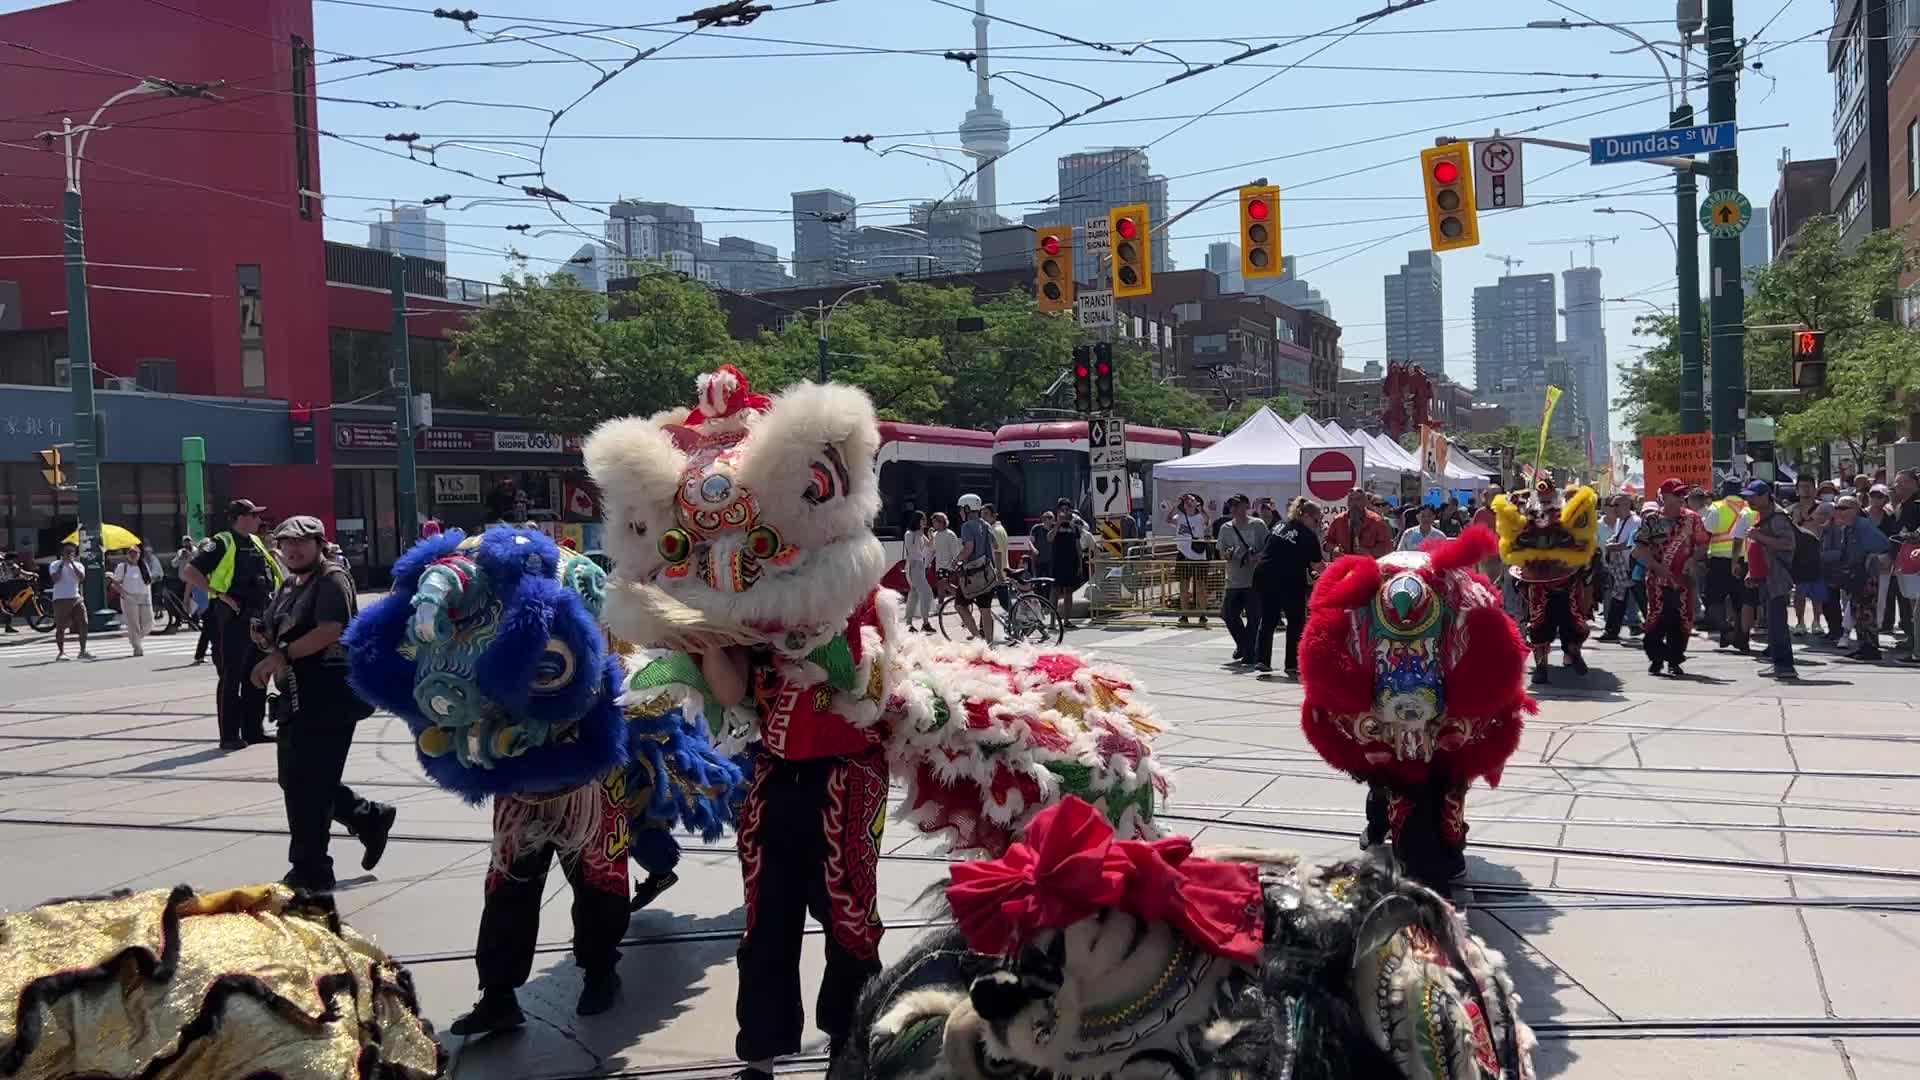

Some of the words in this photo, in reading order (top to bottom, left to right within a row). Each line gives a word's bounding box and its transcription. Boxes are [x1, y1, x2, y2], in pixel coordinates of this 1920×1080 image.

[1606, 135, 1680, 157] Dundas
[1686, 130, 1697, 140] St
[1700, 127, 1719, 146] W
[1087, 220, 1107, 229] LEFT
[1087, 230, 1109, 239] TURN
[1086, 240, 1111, 249] SIGNAL
[1080, 294, 1112, 308] TRANSIT
[1083, 311, 1111, 324] SIGNAL
